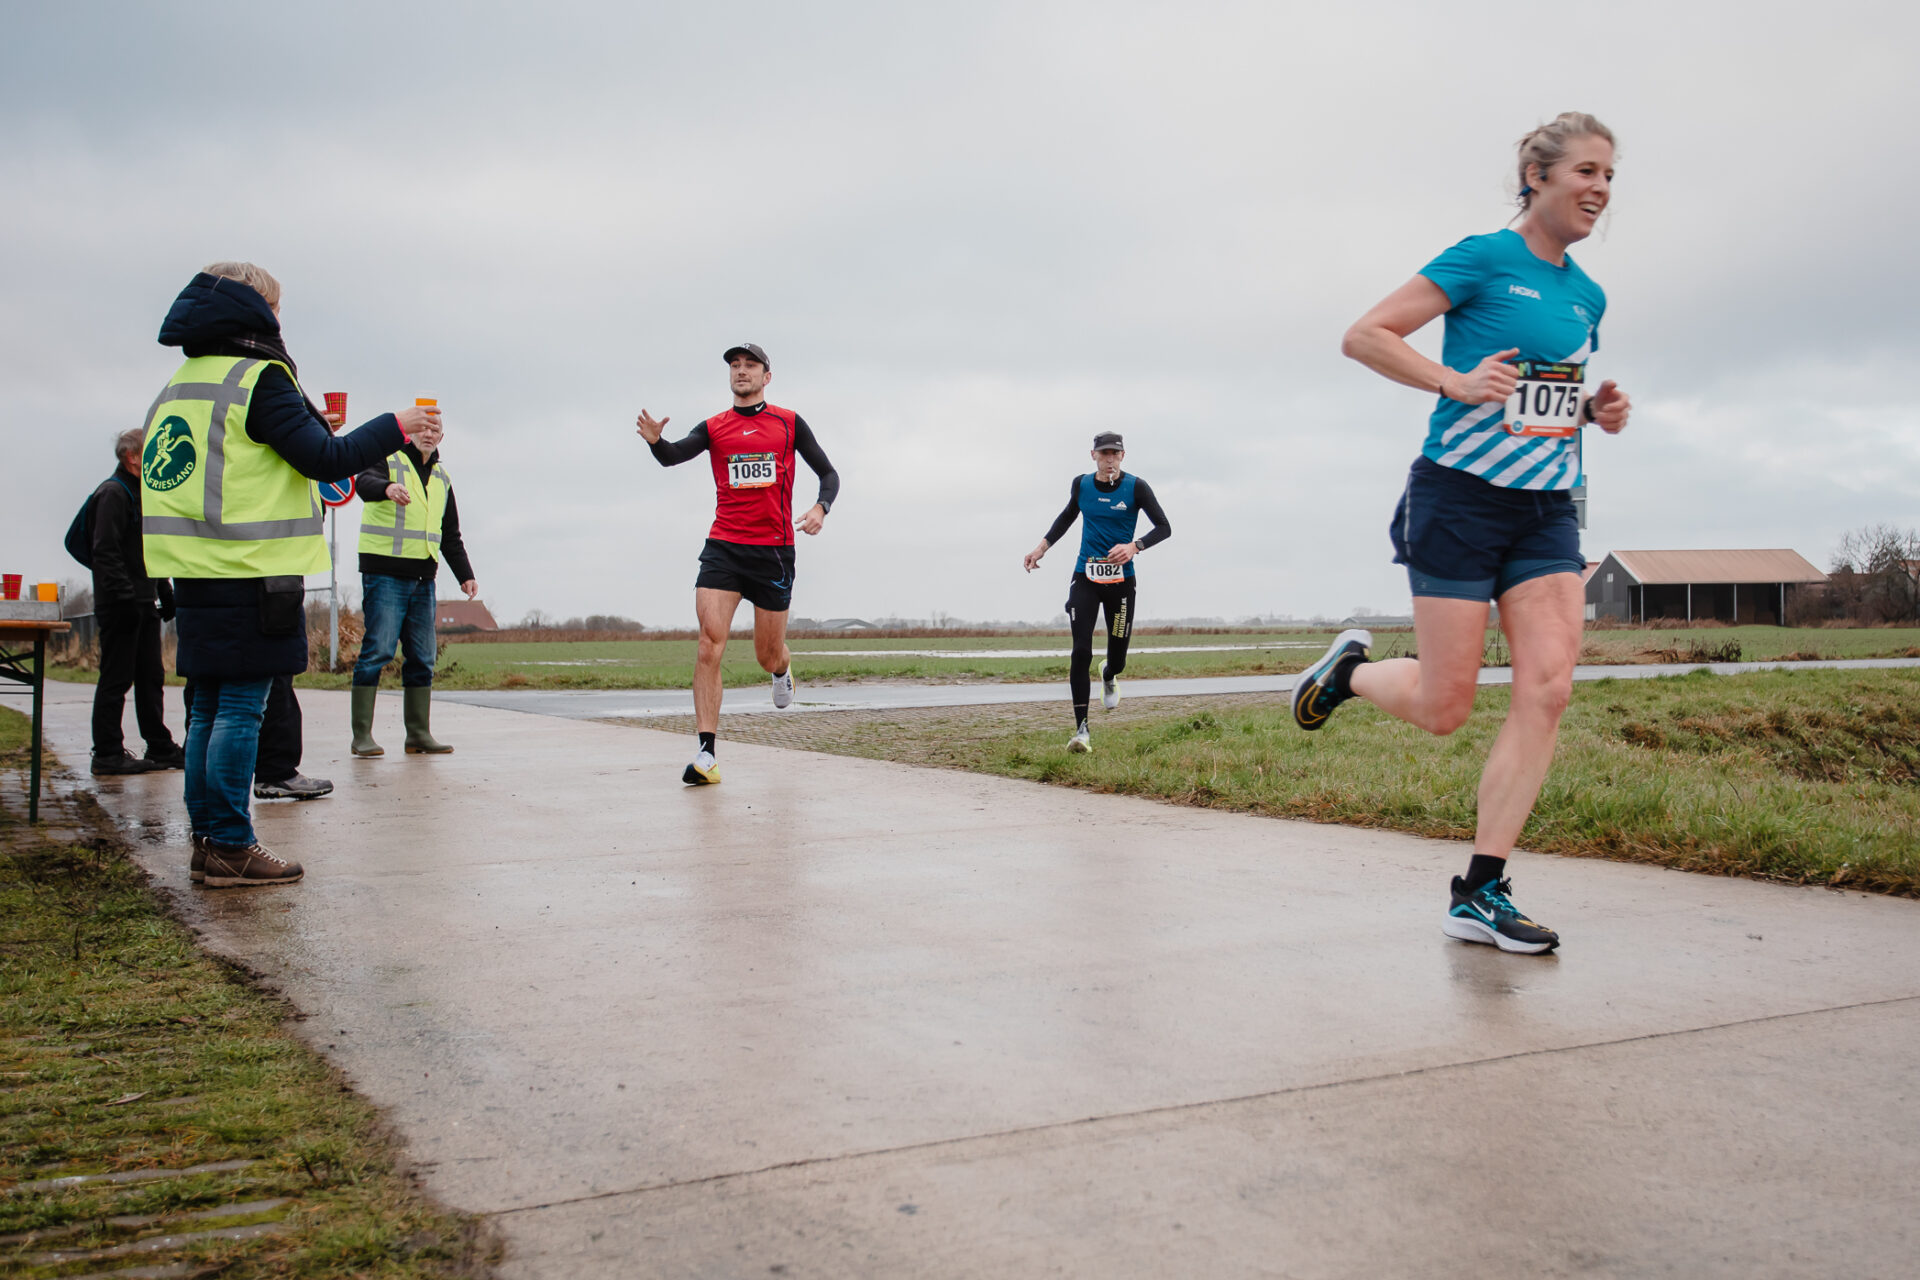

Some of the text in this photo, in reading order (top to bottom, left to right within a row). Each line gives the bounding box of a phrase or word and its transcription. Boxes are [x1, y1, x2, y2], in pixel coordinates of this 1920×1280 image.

[1515, 383, 1579, 417] 1075
[149, 462, 194, 489] FRIESLAND
[732, 463, 772, 479] 1085
[1089, 564, 1121, 576] 1082
